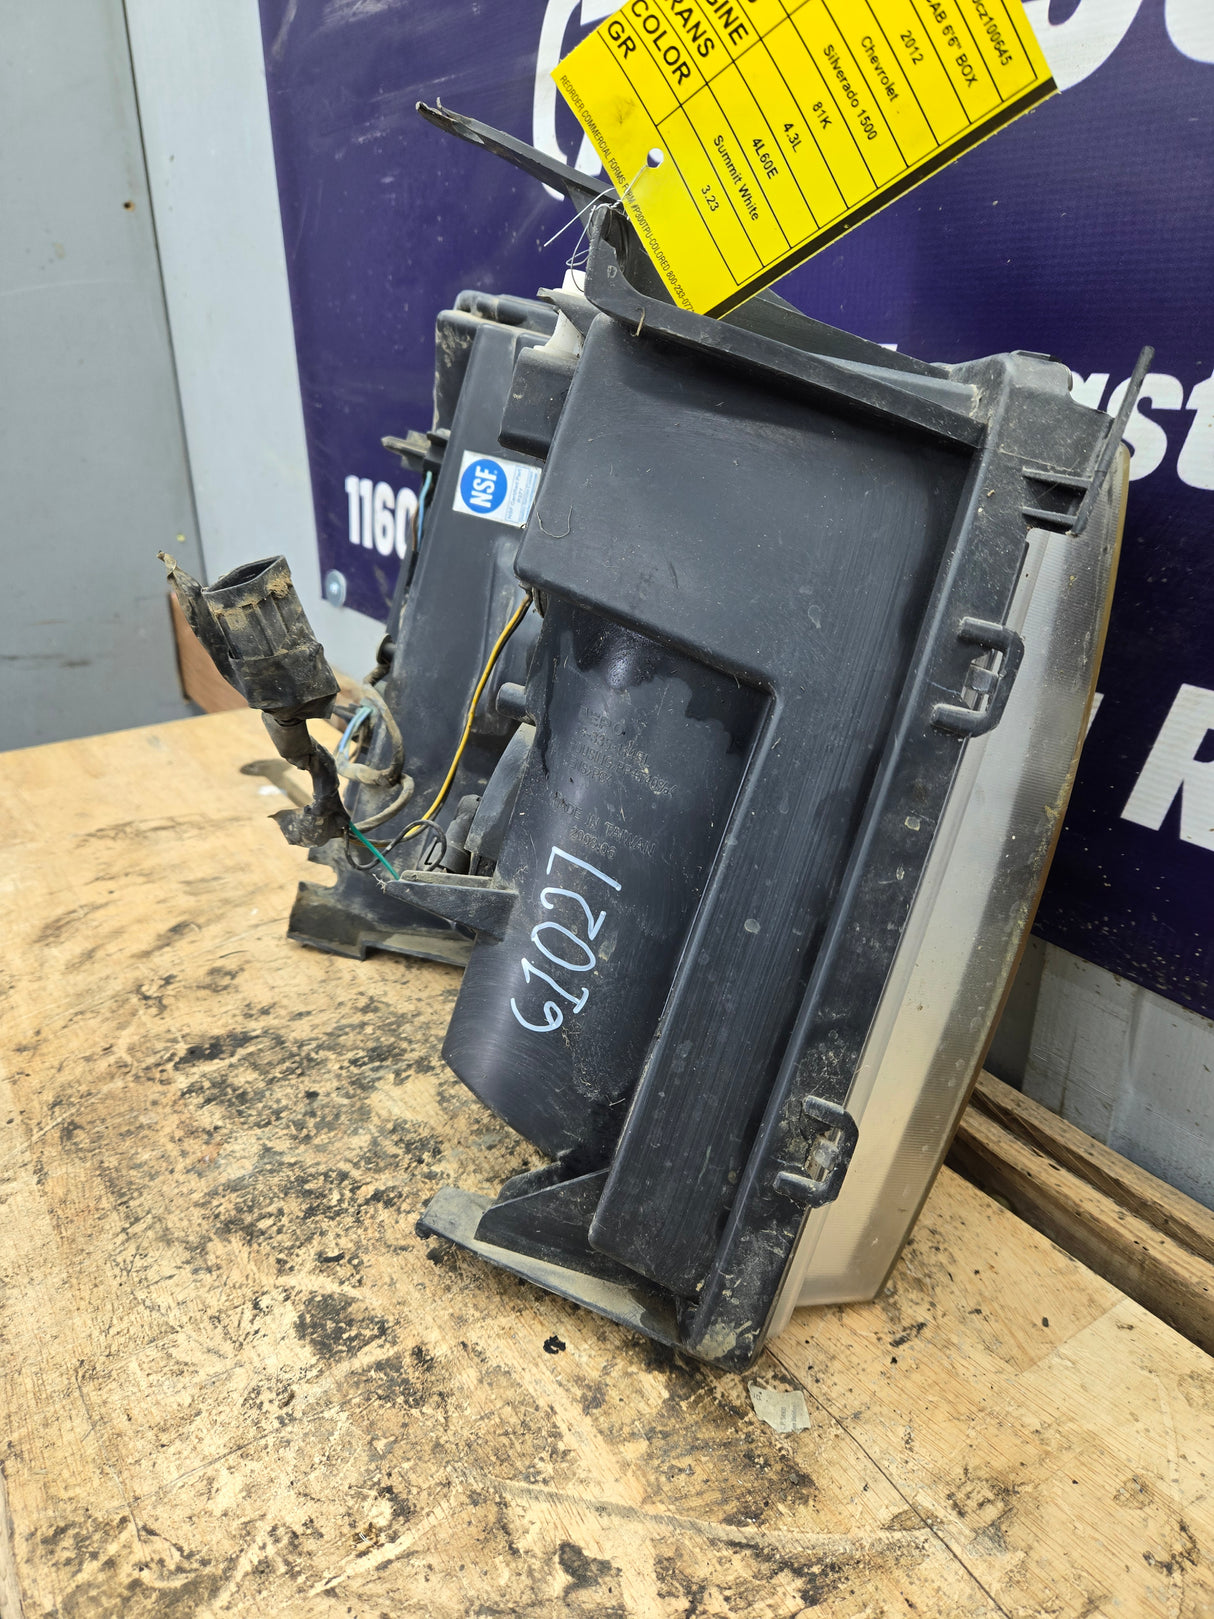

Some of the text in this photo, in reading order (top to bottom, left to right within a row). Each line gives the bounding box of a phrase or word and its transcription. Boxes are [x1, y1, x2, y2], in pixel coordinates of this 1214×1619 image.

[608, 20, 637, 60] GR
[631, 0, 691, 85] COLOR
[900, 30, 924, 65] 2012
[926, 0, 947, 25] AB
[955, 53, 978, 88] BOX
[972, 0, 1013, 67] cz100645
[823, 44, 878, 140] Silverado 1500
[861, 36, 899, 102] Chevrolet
[560, 75, 584, 112] REORDER
[582, 110, 612, 160] COMMERCIAL
[608, 157, 626, 185] FORMS
[783, 122, 803, 153] 4.3L
[812, 101, 832, 130] 81K
[713, 134, 759, 221] Summit White
[752, 137, 778, 180] 4L60E
[701, 184, 720, 212] 3.23
[469, 465, 497, 508] NSF
[604, 821, 657, 858] TAIWAN
[510, 846, 622, 1032] 61027
